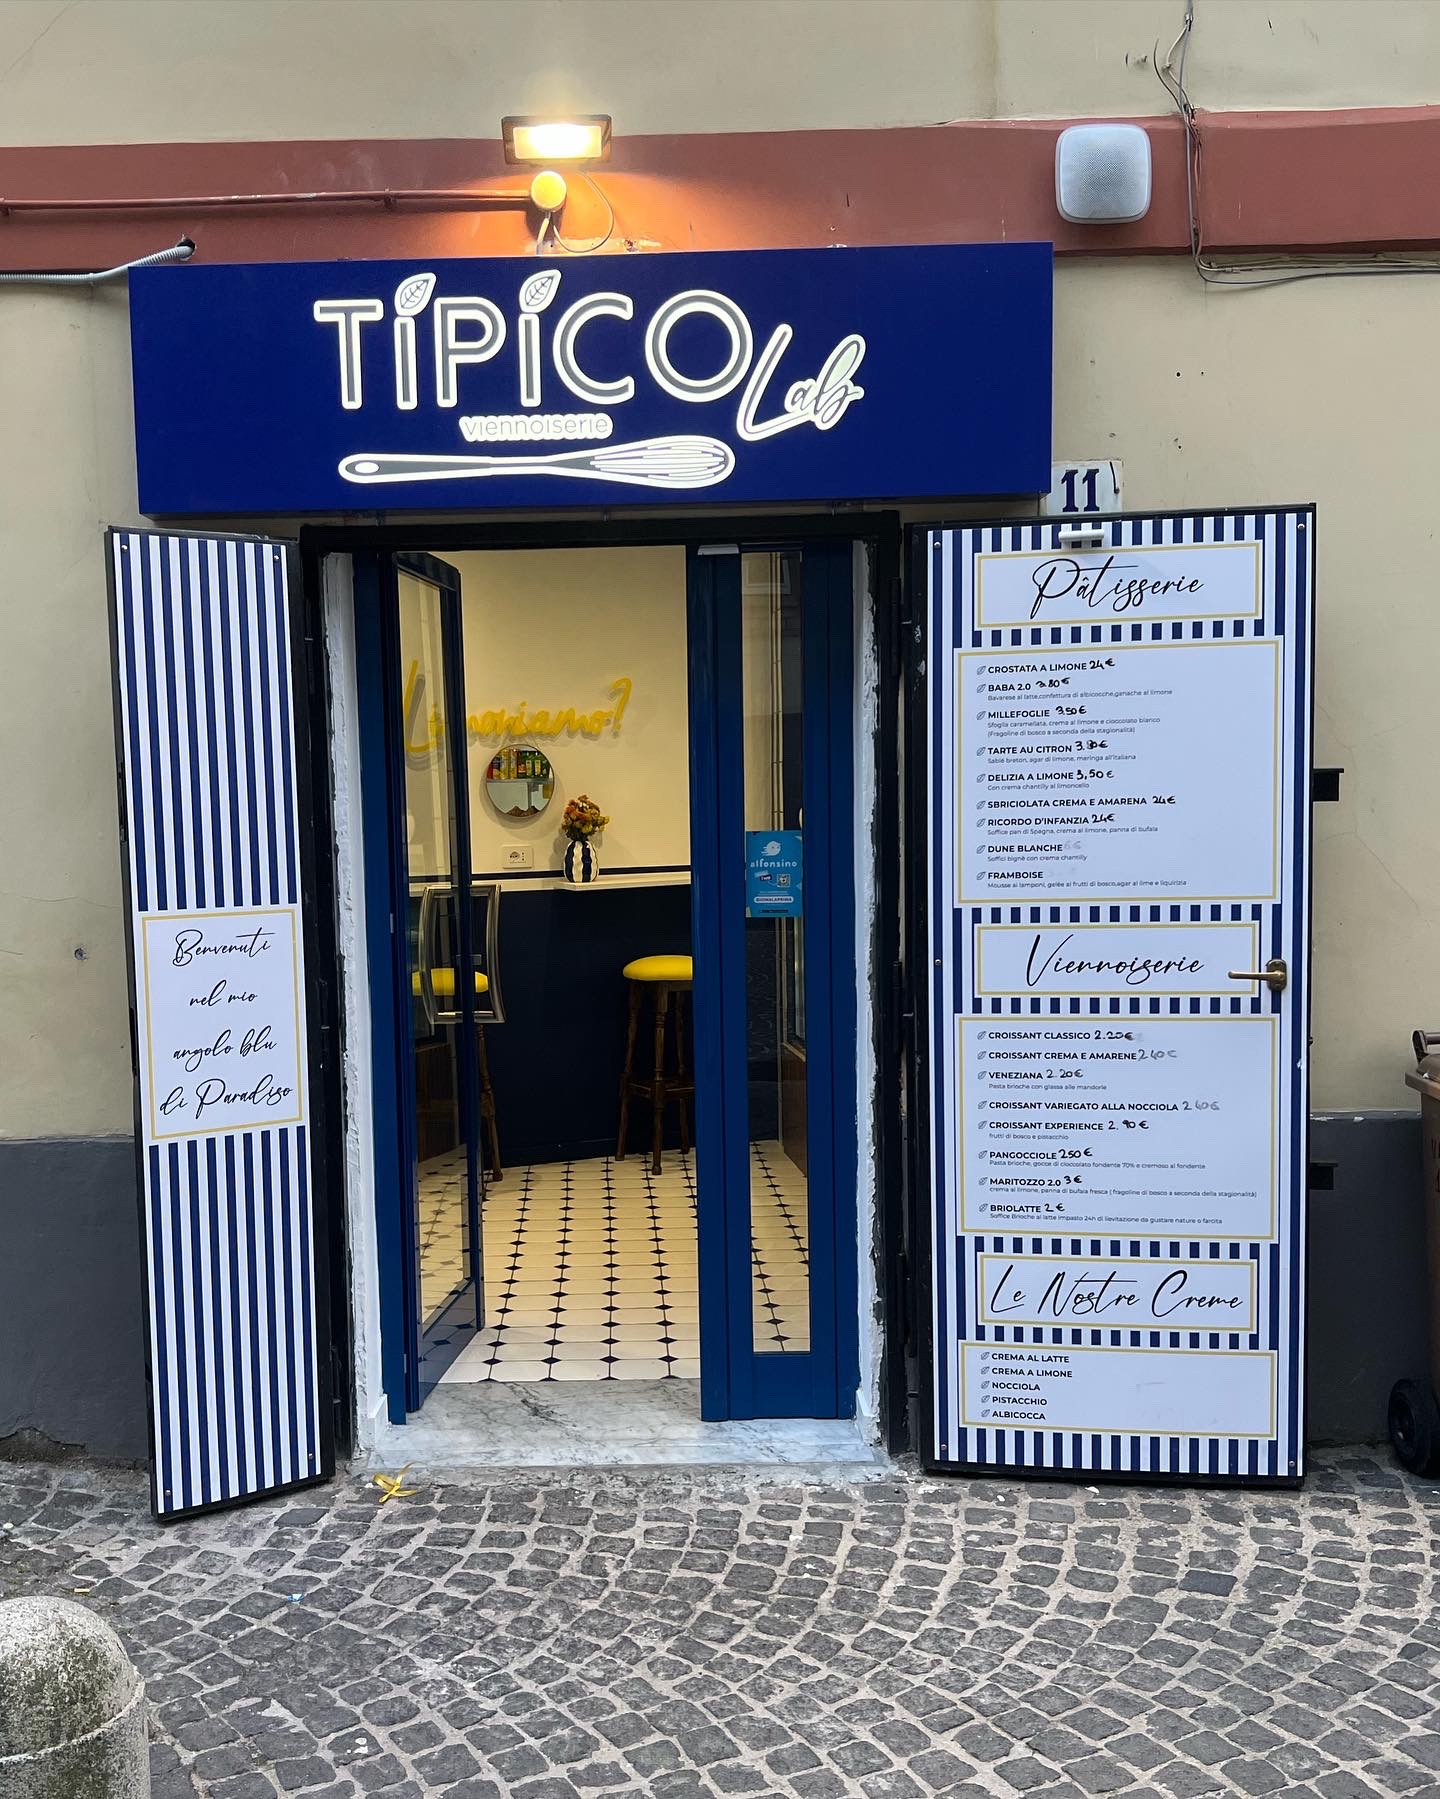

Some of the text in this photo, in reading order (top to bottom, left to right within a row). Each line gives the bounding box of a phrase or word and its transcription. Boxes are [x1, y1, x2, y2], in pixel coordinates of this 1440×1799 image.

[737, 324, 865, 441] Lab
[464, 414, 611, 439] viennoiserie
[1061, 468, 1100, 512] 11
[1030, 555, 1203, 619] Pâtisserie
[988, 665, 1038, 674] CROSTATA
[1040, 664, 1047, 672] A
[1049, 662, 1087, 672] LIMONE
[988, 684, 1016, 692] BABA
[1017, 683, 1032, 691] 2.0
[988, 709, 1051, 719] MILLEFOGLIE
[988, 747, 1017, 755] TARTE
[1020, 746, 1034, 754] AU
[1036, 745, 1072, 753] CITRON
[988, 773, 1025, 782] DELIZIA
[1027, 773, 1034, 781] A
[1036, 772, 1074, 780] LIMONE
[1022, 783, 1049, 791] chantilly
[988, 795, 1176, 809] SBRICIOLATA CREMA E AMARENA 24€
[988, 818, 1032, 826] RICORDO
[1034, 816, 1089, 825] D'INFANZIA
[988, 845, 1015, 853] DUNE
[1017, 844, 1063, 852] BLANCHE
[750, 859, 798, 868] alfonsino
[988, 871, 1044, 880] FRAMBOISE
[172, 927, 276, 967] Benvenuti
[1026, 933, 1205, 987] Viennoiserie
[189, 979, 258, 1007] nel mio
[988, 1032, 1042, 1040] CROISSANT
[1044, 1032, 1091, 1040] CLASSICO
[173, 1025, 277, 1072] angolo blu
[988, 1051, 1042, 1060] CROISSANT
[1044, 1052, 1079, 1060] CREMA
[1081, 1052, 1087, 1060] E
[1088, 1052, 1137, 1060] AMARENE
[988, 1071, 1044, 1080] VENEZIANA
[159, 1073, 293, 1119] di Paradiso
[989, 1101, 1042, 1110] CROISSANT
[1044, 1102, 1099, 1110] VARIEGATO
[1101, 1103, 1126, 1111] ALLA
[1128, 1103, 1179, 1111] NOCCIOLA
[989, 1121, 1042, 1130] CROISSANT
[1044, 1122, 1104, 1131] EXPERIENCE
[989, 1151, 1057, 1160] PANGOCCIOLE
[989, 1178, 1046, 1186] MARITOZZO
[1047, 1179, 1062, 1187] 2.0
[990, 1204, 1041, 1213] BRIOLATTE
[991, 1264, 1243, 1318] Le Nostre Creme
[992, 1352, 1070, 1364] CREMA AL LATTE
[992, 1367, 1073, 1378] CREMA A LIMONE
[992, 1381, 1041, 1391] NOCCIOLA
[992, 1396, 1048, 1406] PISTACCHIO
[992, 1410, 1046, 1420] ALBICOCCA
